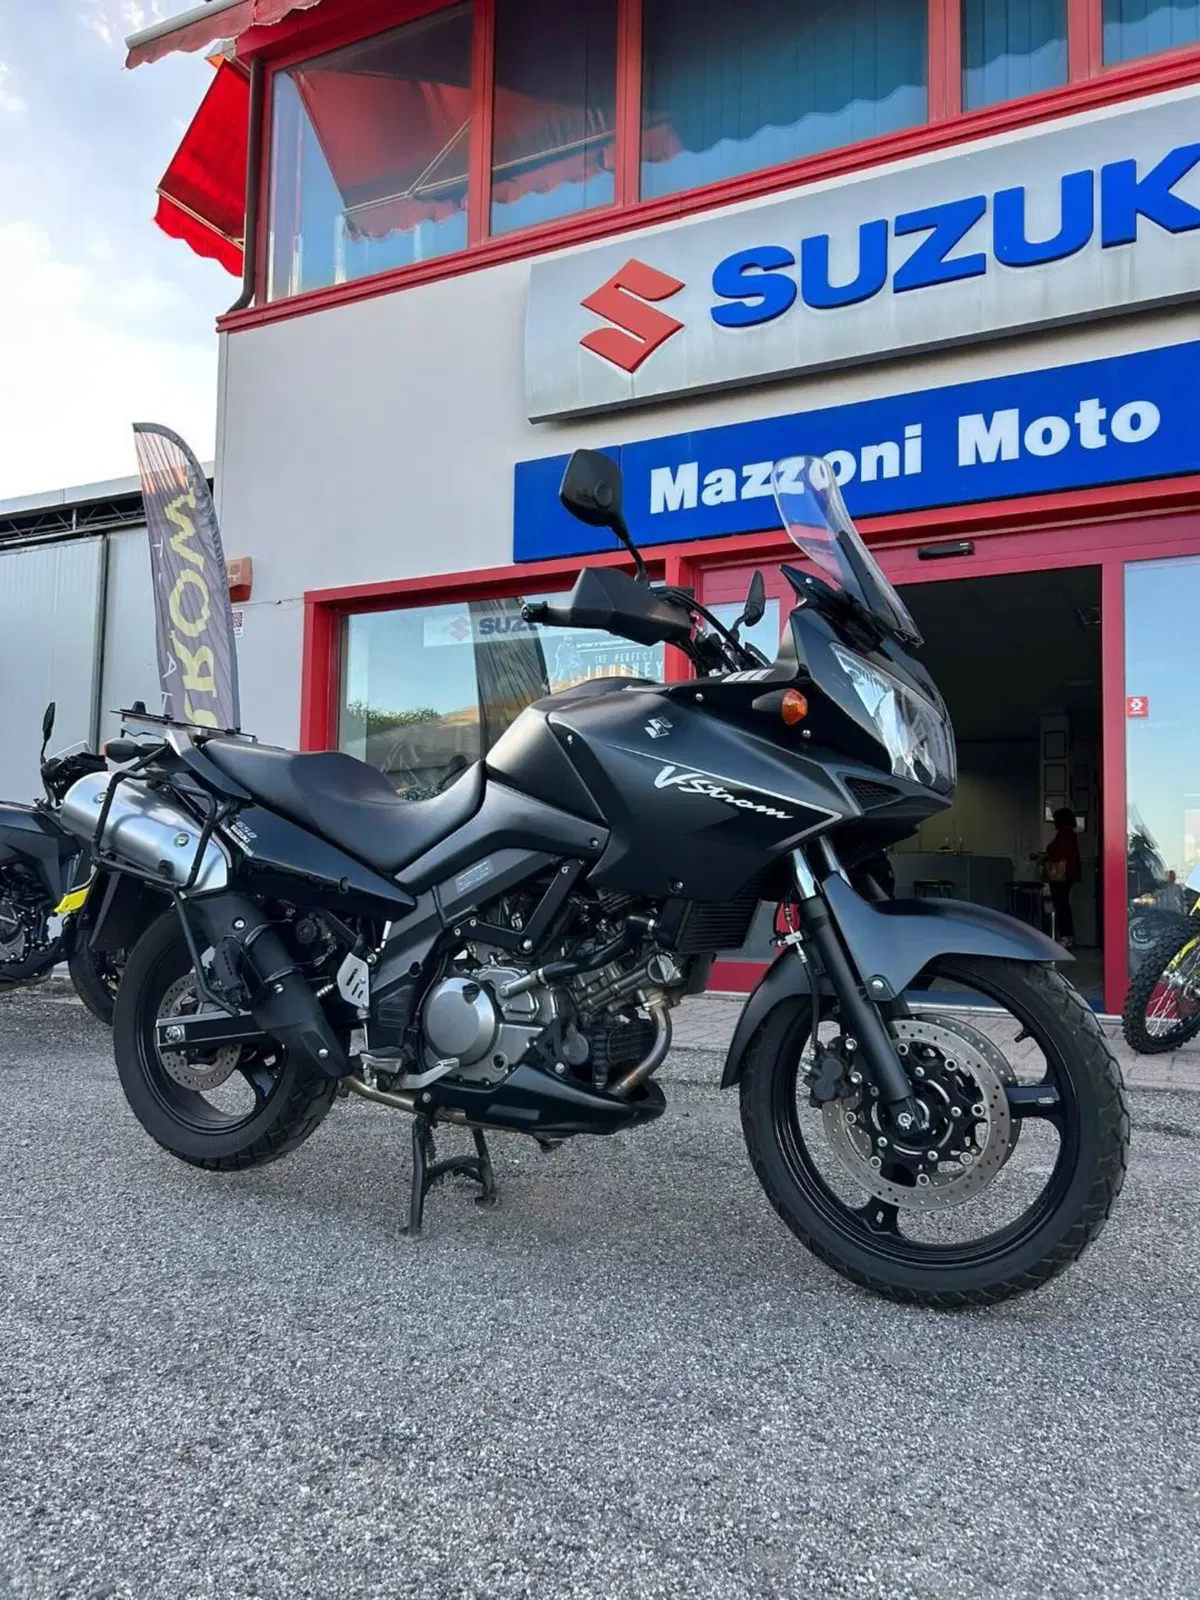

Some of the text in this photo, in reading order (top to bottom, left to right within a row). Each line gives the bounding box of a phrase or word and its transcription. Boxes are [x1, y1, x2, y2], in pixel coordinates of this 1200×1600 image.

[650, 398, 1161, 513] Mazzoni Moto
[584, 660, 664, 681] JOURNEY
